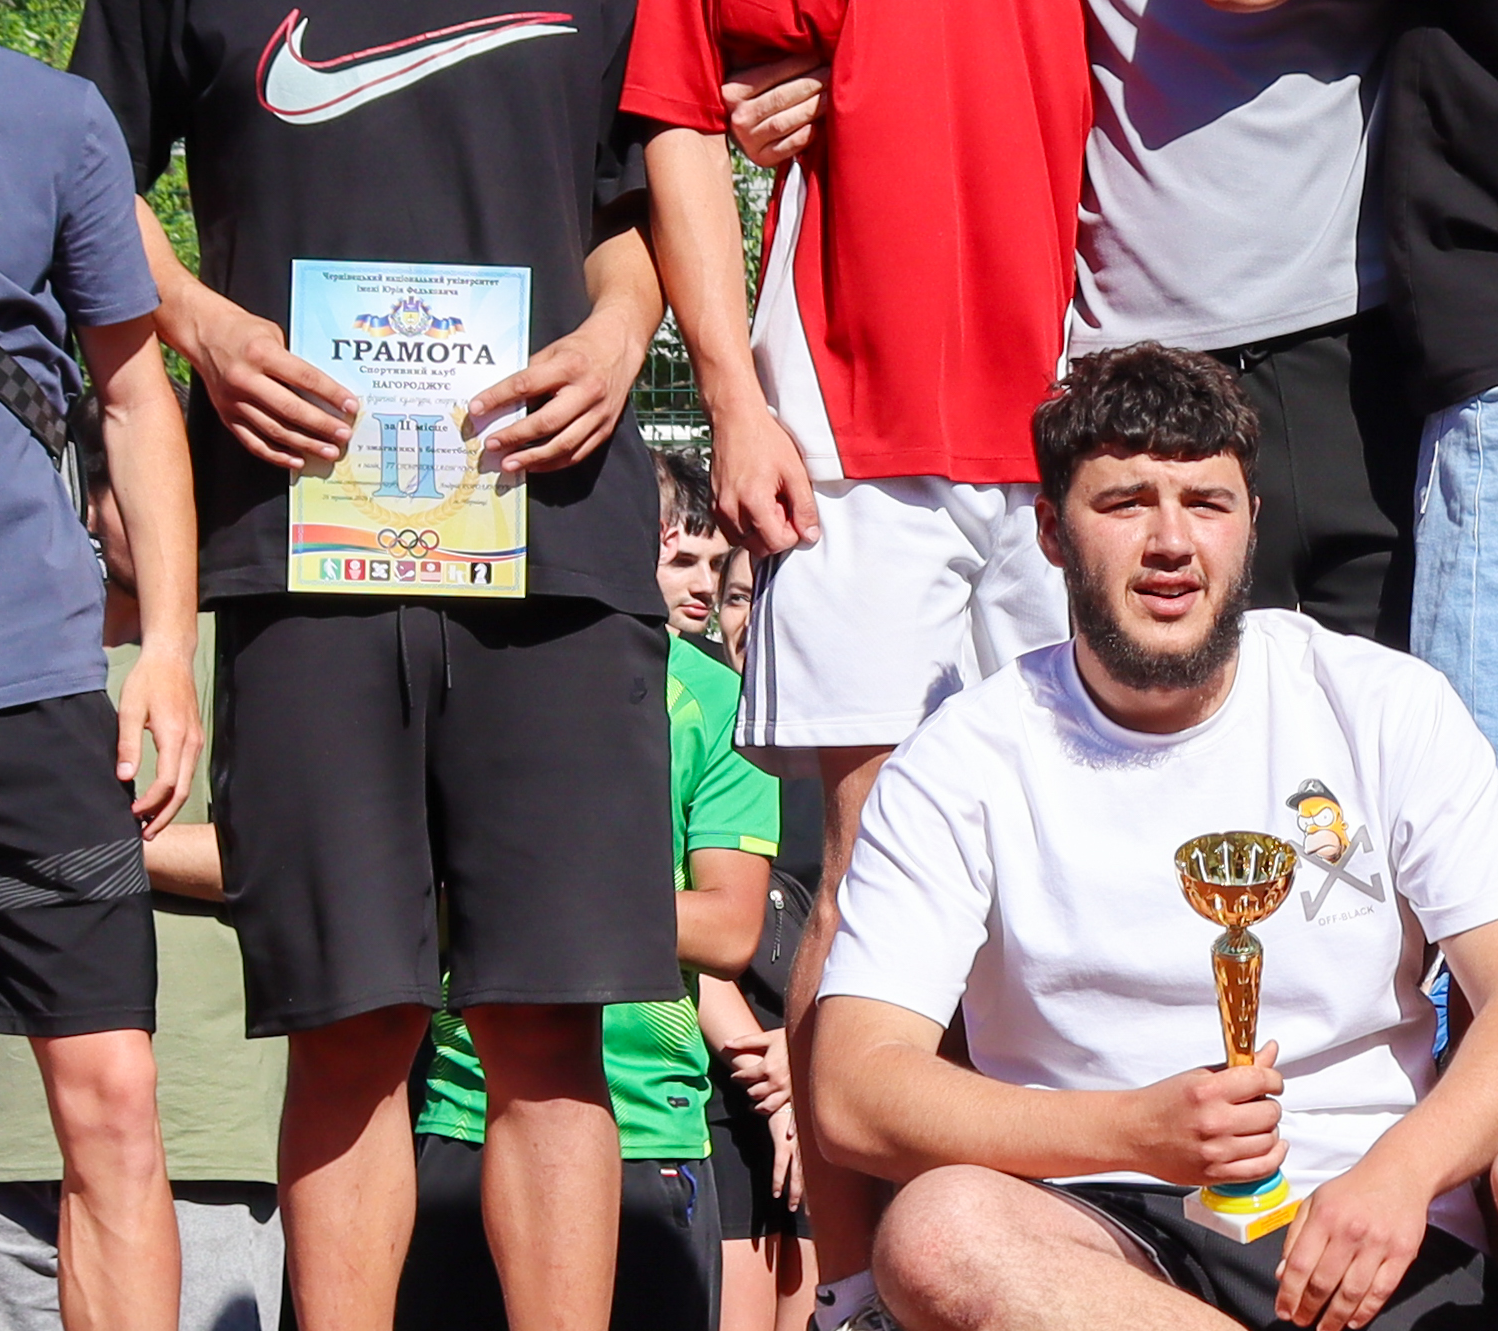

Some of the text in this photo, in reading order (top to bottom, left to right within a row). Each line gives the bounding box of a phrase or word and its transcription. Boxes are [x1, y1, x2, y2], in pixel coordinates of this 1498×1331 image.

[331, 338, 496, 366] ГРАМОТА
[372, 379, 451, 391] НАГОРОДЖУЄ
[372, 412, 444, 498] II
[1318, 904, 1375, 926] OFF-BLACK
